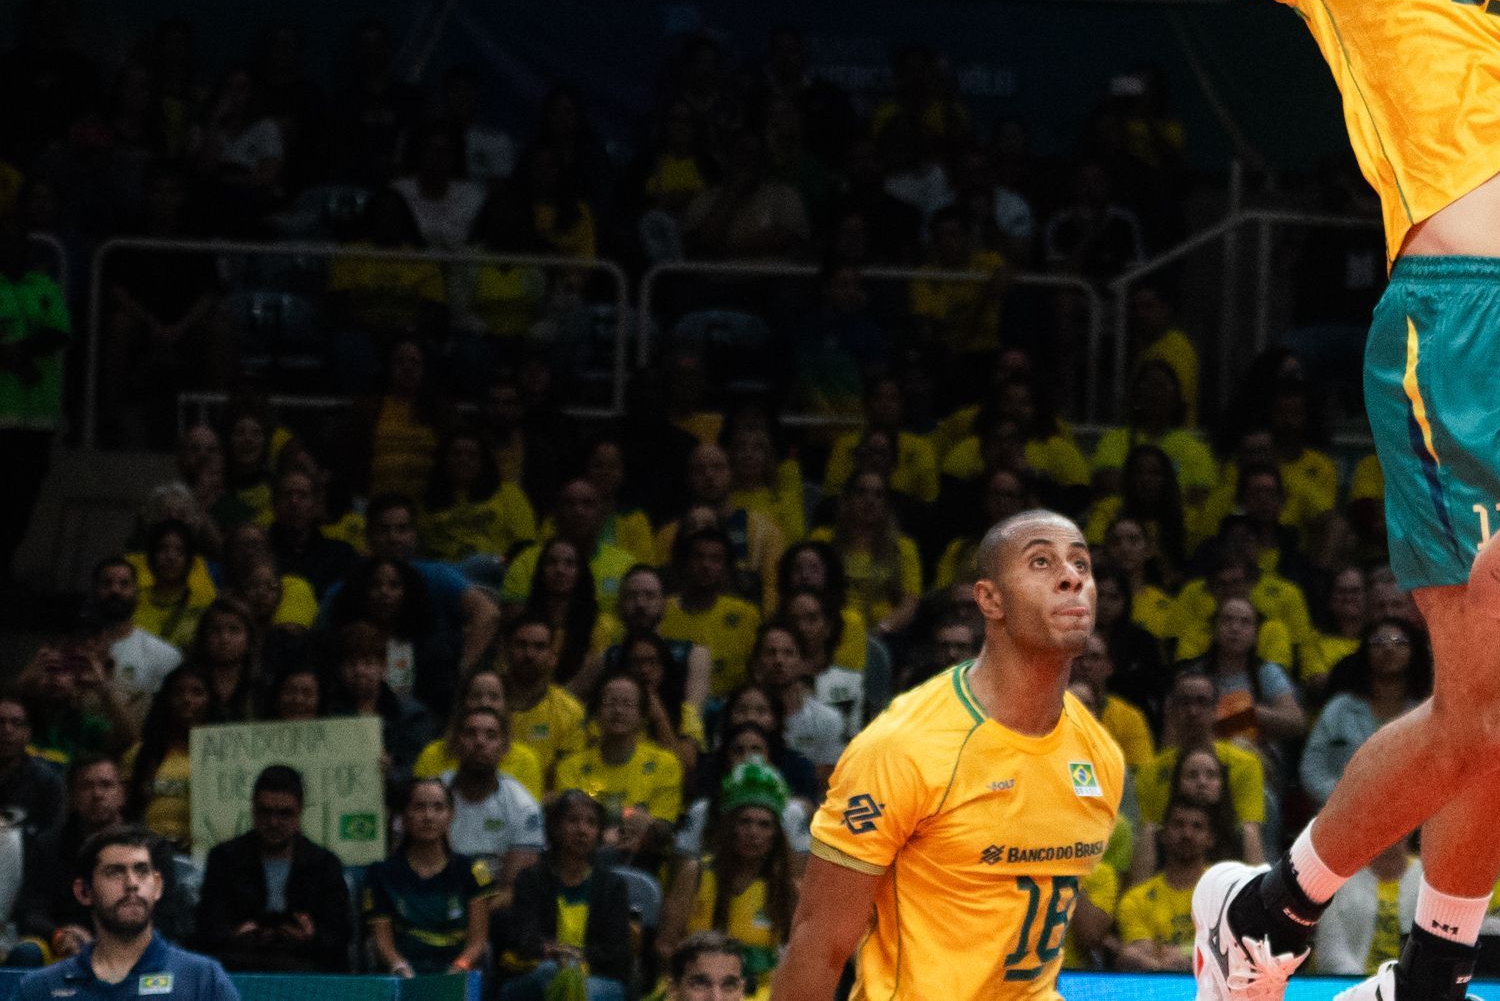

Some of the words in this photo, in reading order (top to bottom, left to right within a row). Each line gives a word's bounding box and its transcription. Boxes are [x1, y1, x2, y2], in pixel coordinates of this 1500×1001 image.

[1007, 847, 1054, 863] BANCO
[1056, 846, 1073, 859] DO
[1004, 875, 1079, 982] 18
